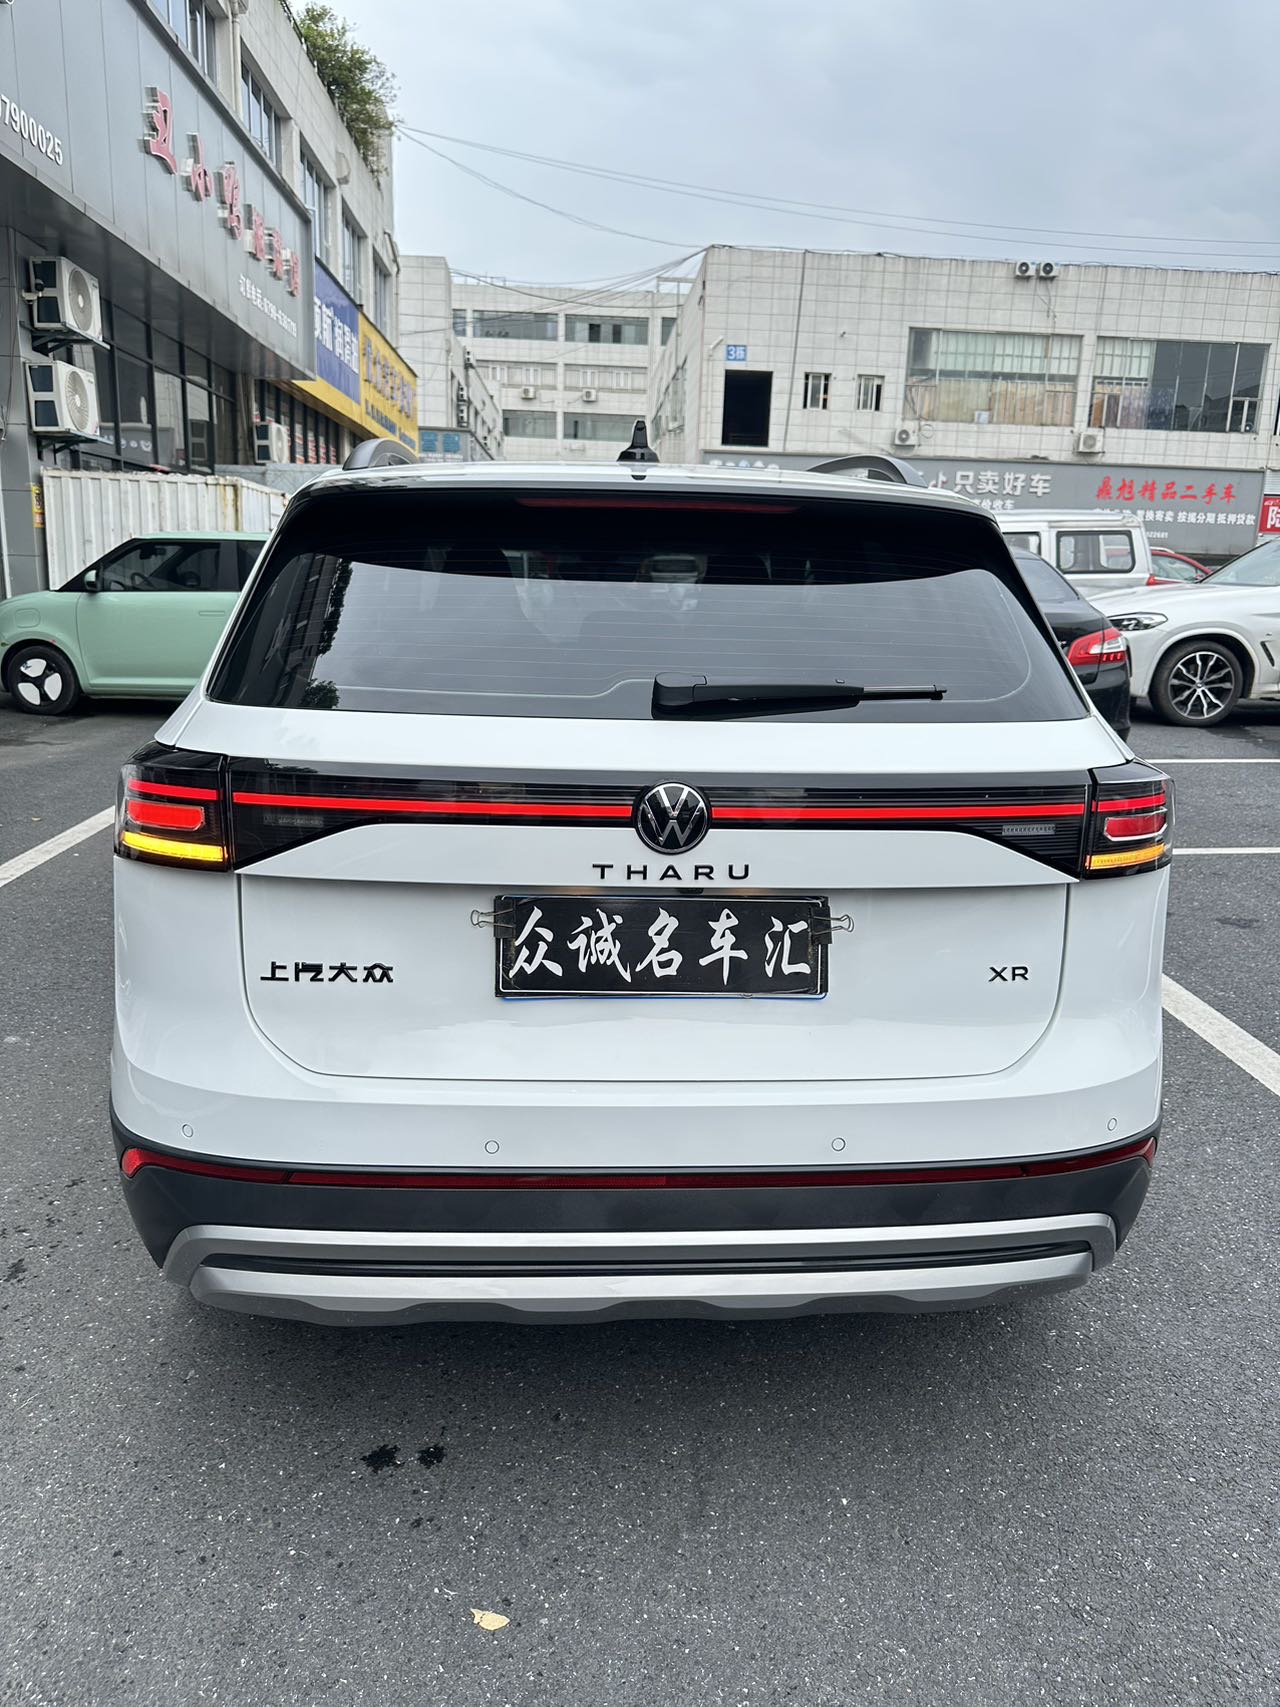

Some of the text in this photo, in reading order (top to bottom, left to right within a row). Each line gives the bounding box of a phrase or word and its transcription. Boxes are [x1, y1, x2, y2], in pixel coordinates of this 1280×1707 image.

[0, 94, 63, 166] 7900025
[592, 864, 750, 881] THARU
[509, 906, 812, 986] 众诚名车汇
[260, 961, 393, 982] 上汽大众
[988, 966, 1029, 982] XR
